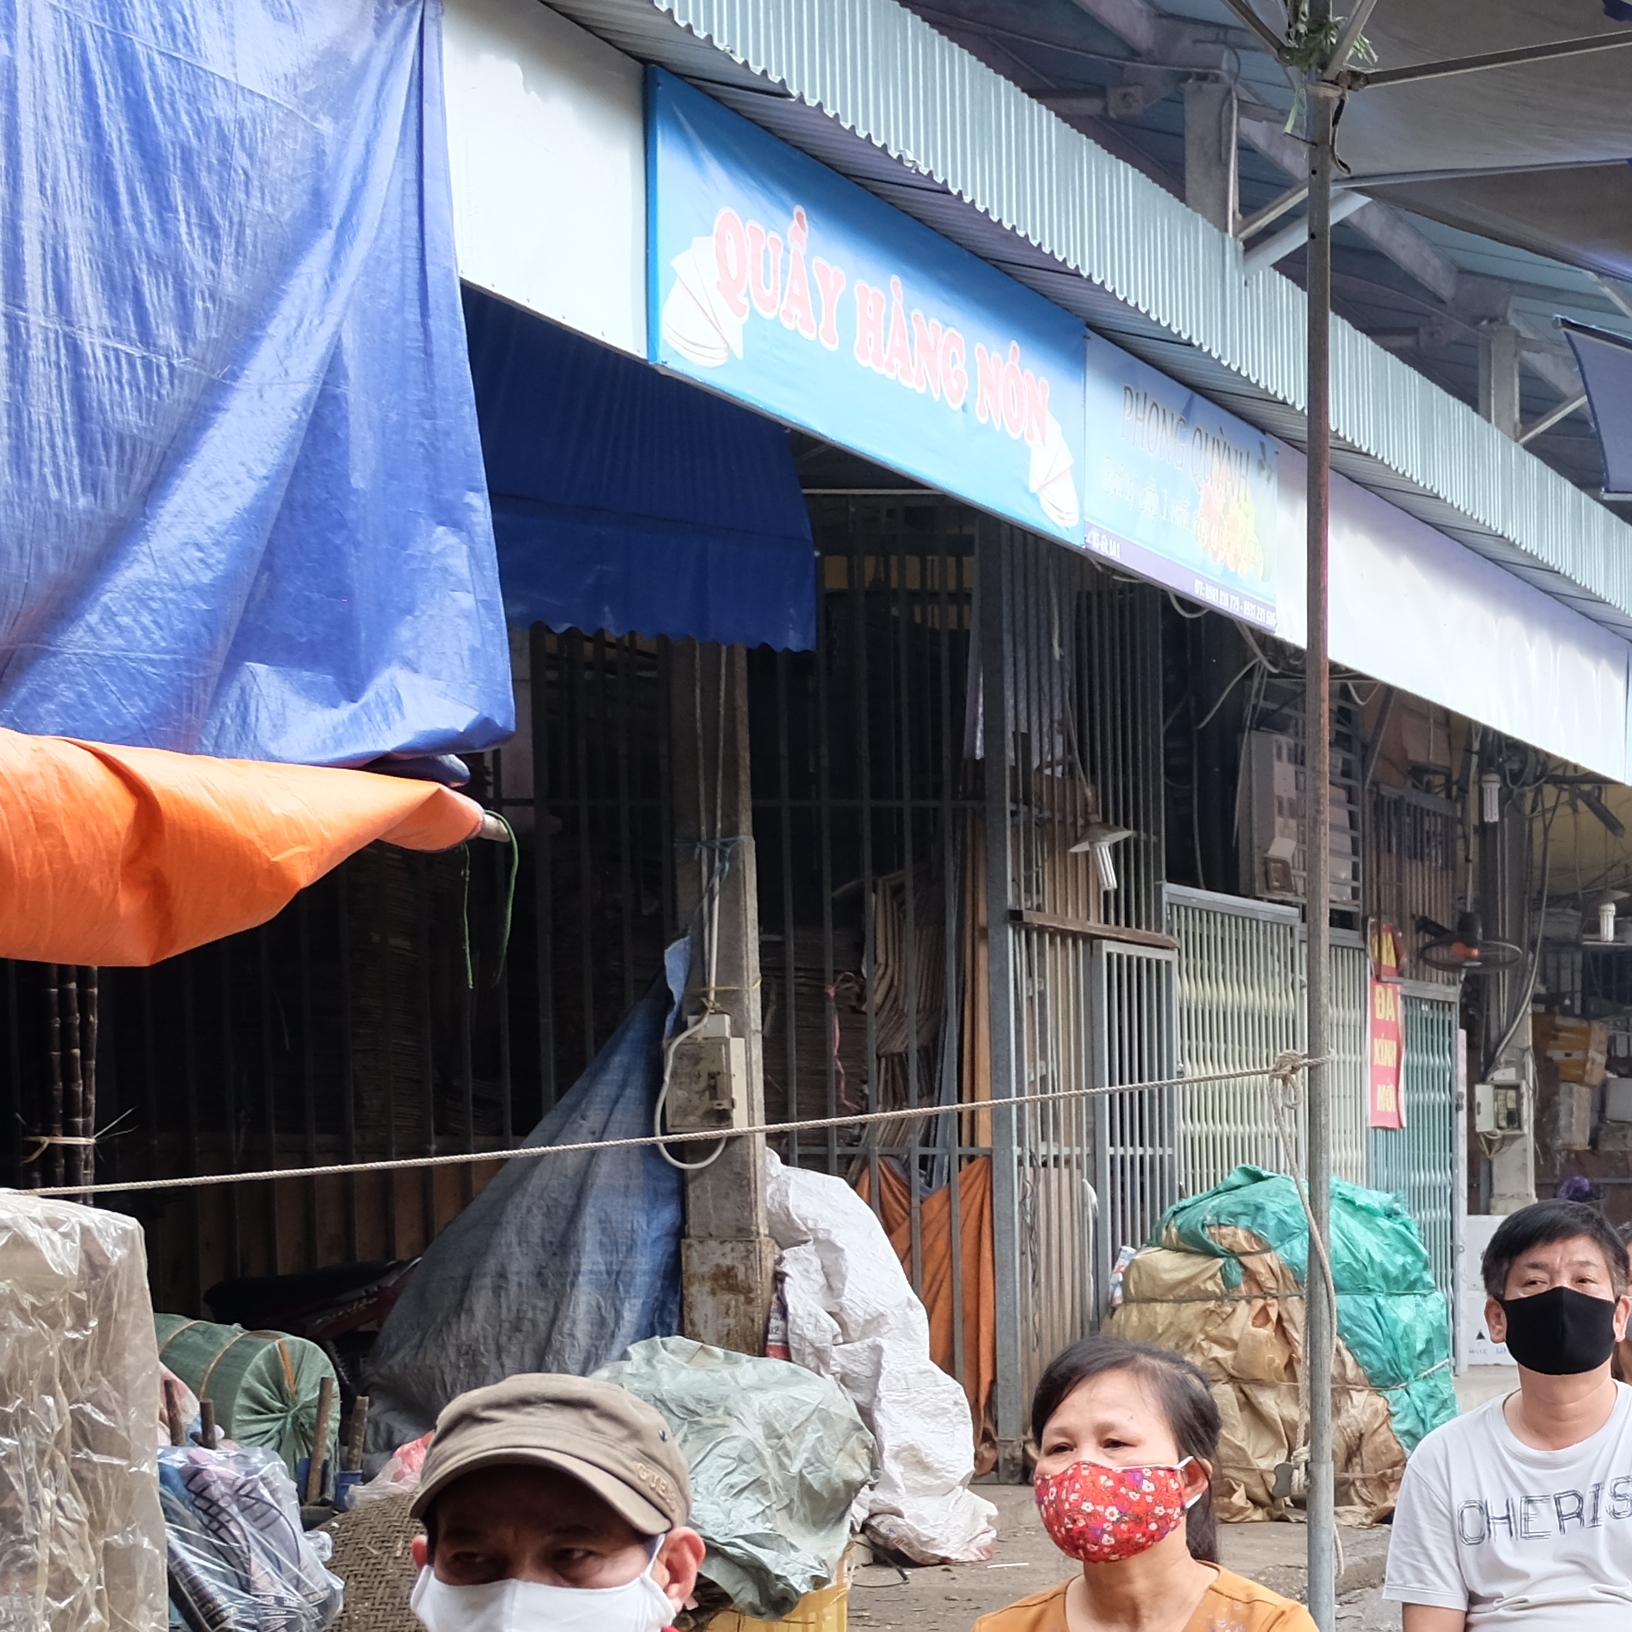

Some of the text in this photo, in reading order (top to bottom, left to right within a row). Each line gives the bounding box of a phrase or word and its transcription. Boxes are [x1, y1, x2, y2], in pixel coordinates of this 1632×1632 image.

[855, 275, 968, 411] HÀNG
[975, 340, 1049, 448] NÓN
[1120, 384, 1188, 472] PHONG
